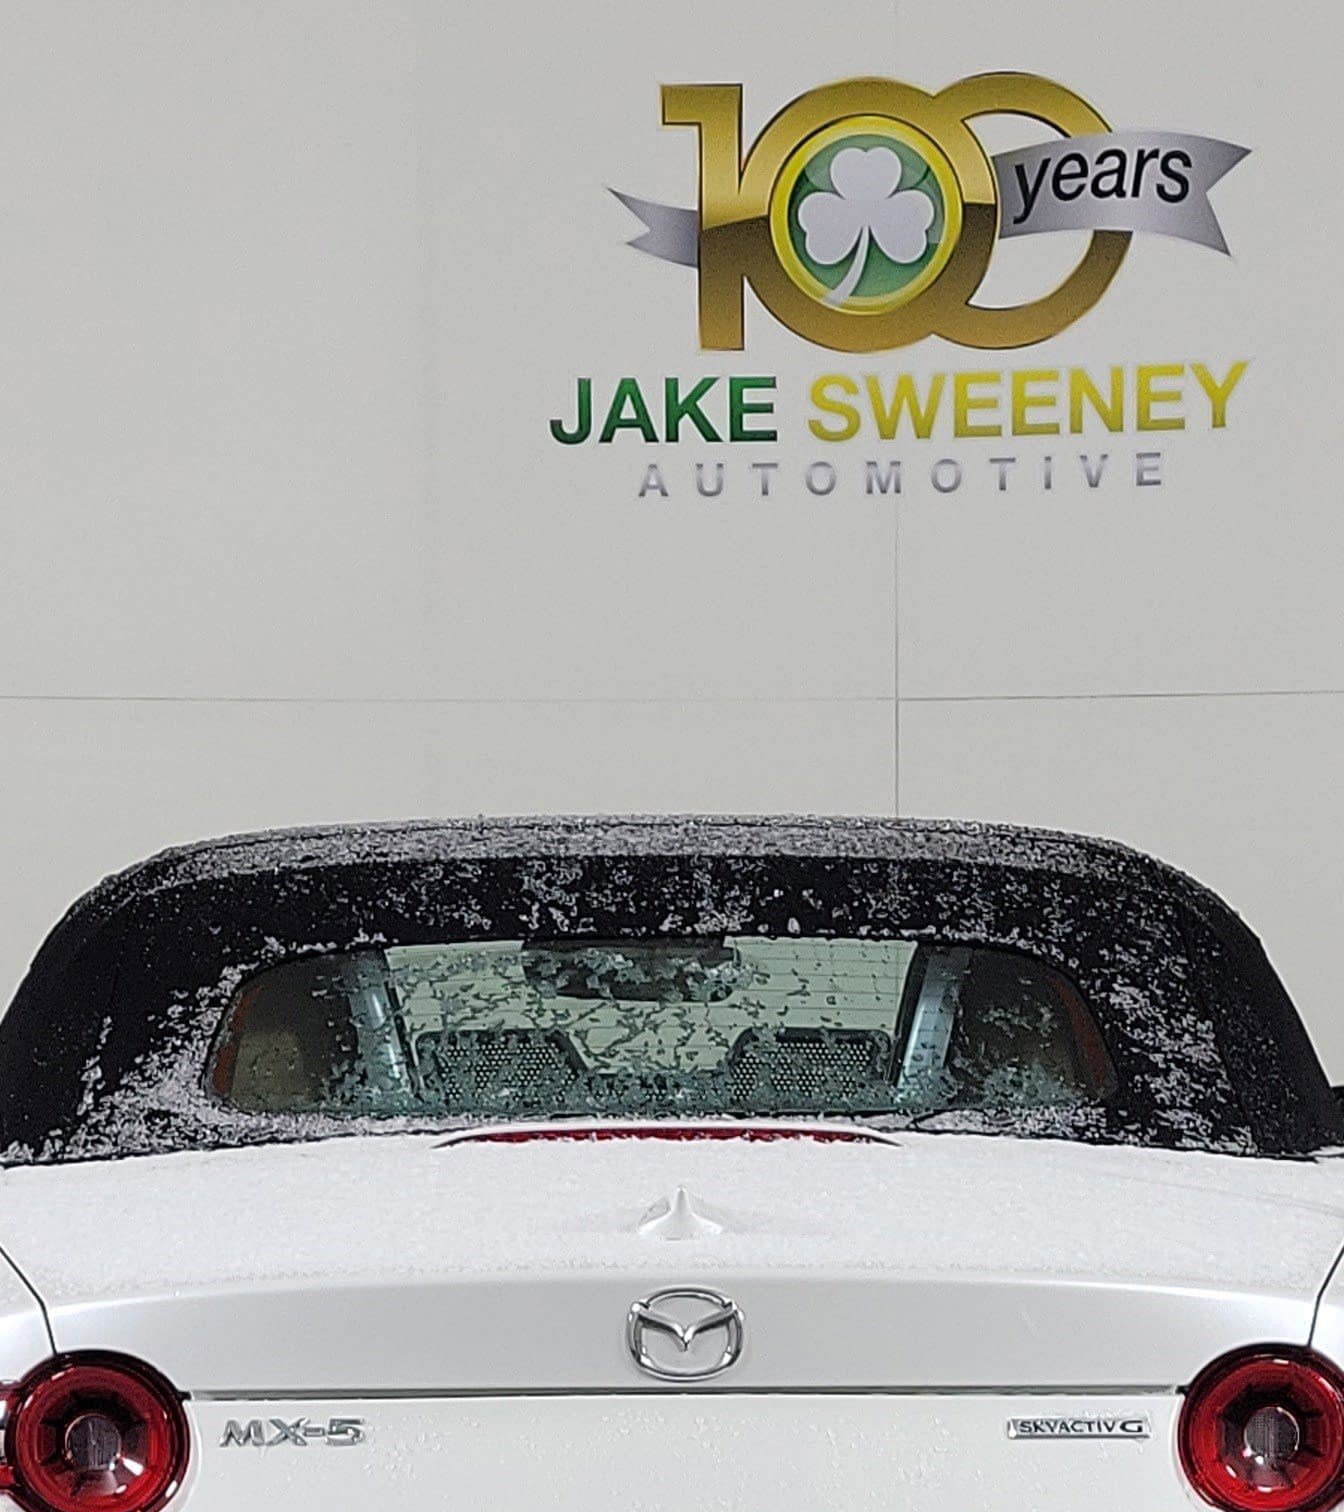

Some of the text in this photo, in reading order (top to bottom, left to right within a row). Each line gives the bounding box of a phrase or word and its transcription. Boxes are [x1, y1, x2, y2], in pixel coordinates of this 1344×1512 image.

[660, 71, 1193, 353] 100 years
[549, 361, 1249, 445] JAKE SWEENEY
[637, 452, 1163, 498] AUTOMOTIVE
[219, 1418, 365, 1447] MX-5
